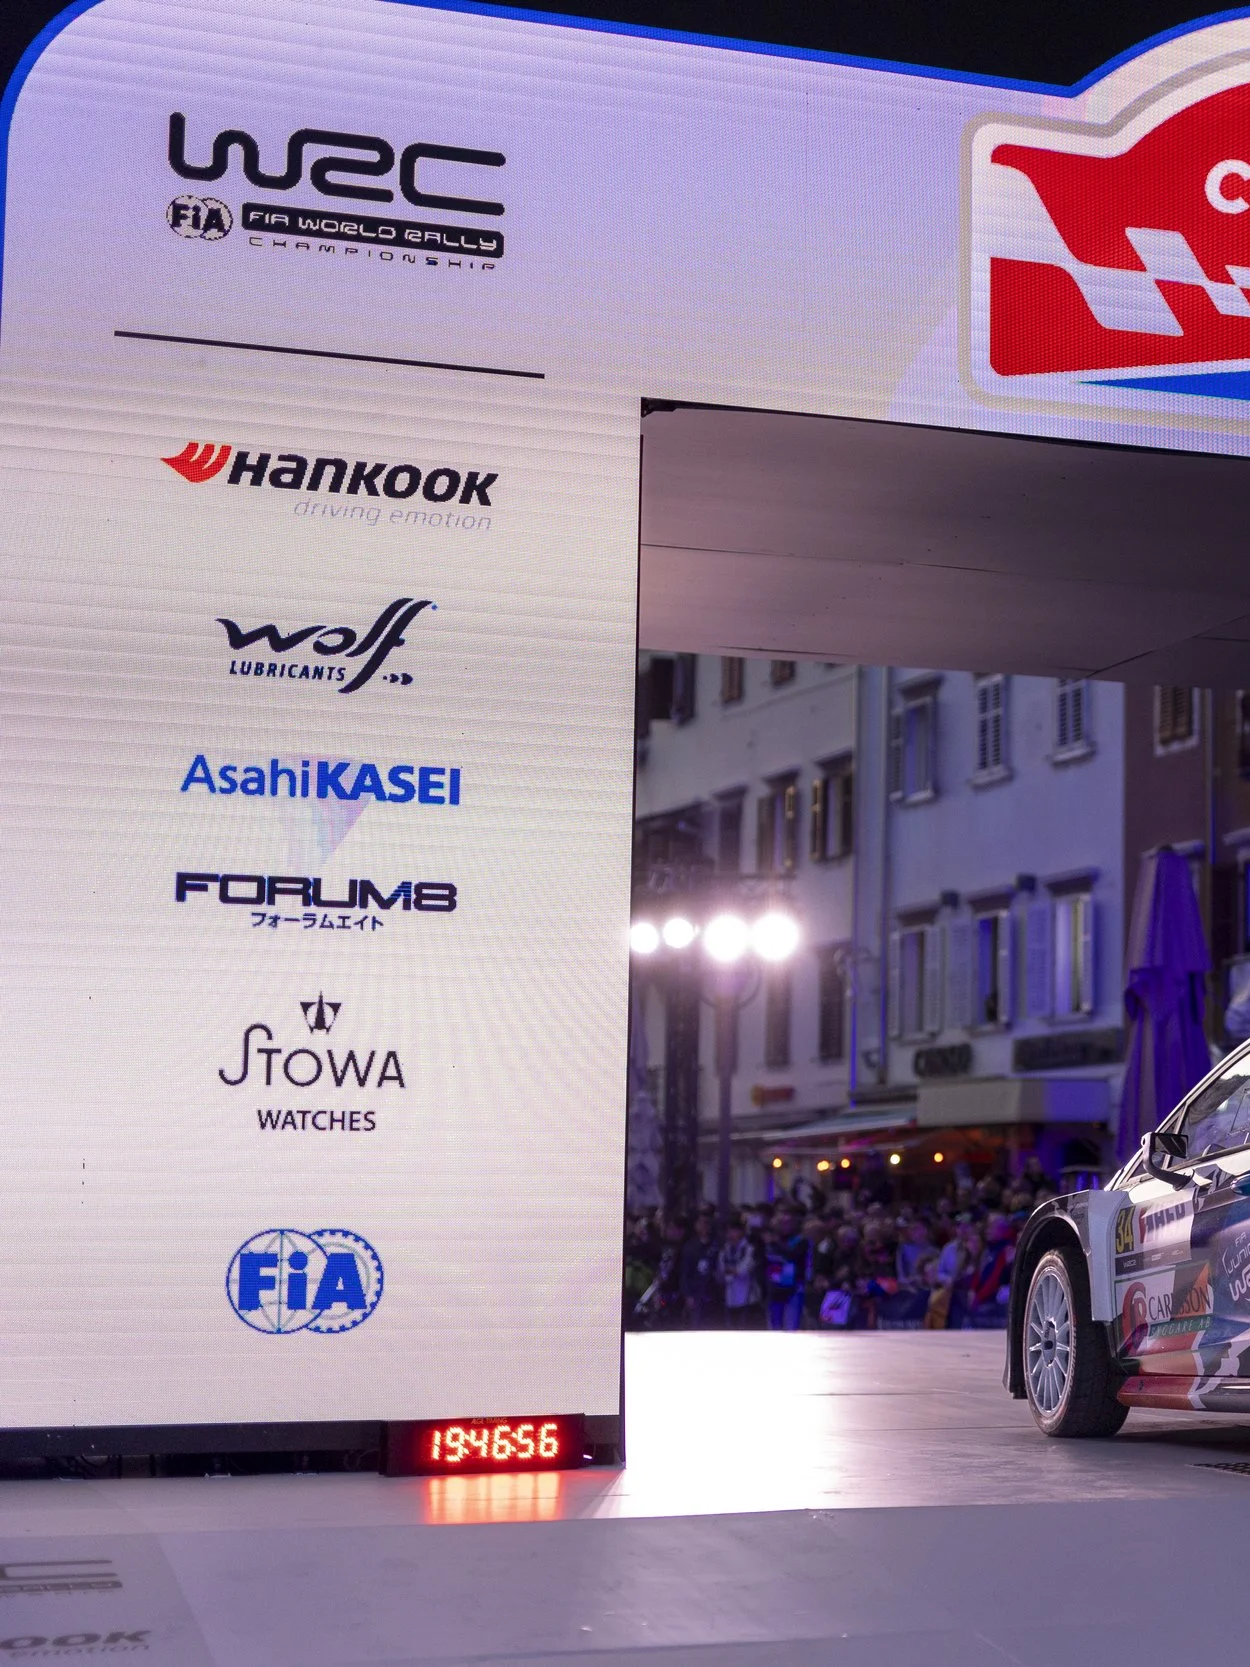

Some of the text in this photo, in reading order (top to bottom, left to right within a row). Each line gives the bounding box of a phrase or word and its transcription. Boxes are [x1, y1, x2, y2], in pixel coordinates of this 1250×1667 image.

[169, 112, 506, 216] WRC
[249, 211, 498, 252] FIA WORLD RALLY
[249, 237, 497, 271] CHAMPIONSHIP
[294, 497, 493, 532] driving emotion
[229, 660, 347, 682] LUBRICANTS
[175, 871, 458, 913] FORUM8
[251, 912, 384, 931] フォーラムエイト
[219, 1023, 406, 1088] STOWA
[257, 1109, 377, 1132] WATCHES
[1115, 1205, 1136, 1254] 34
